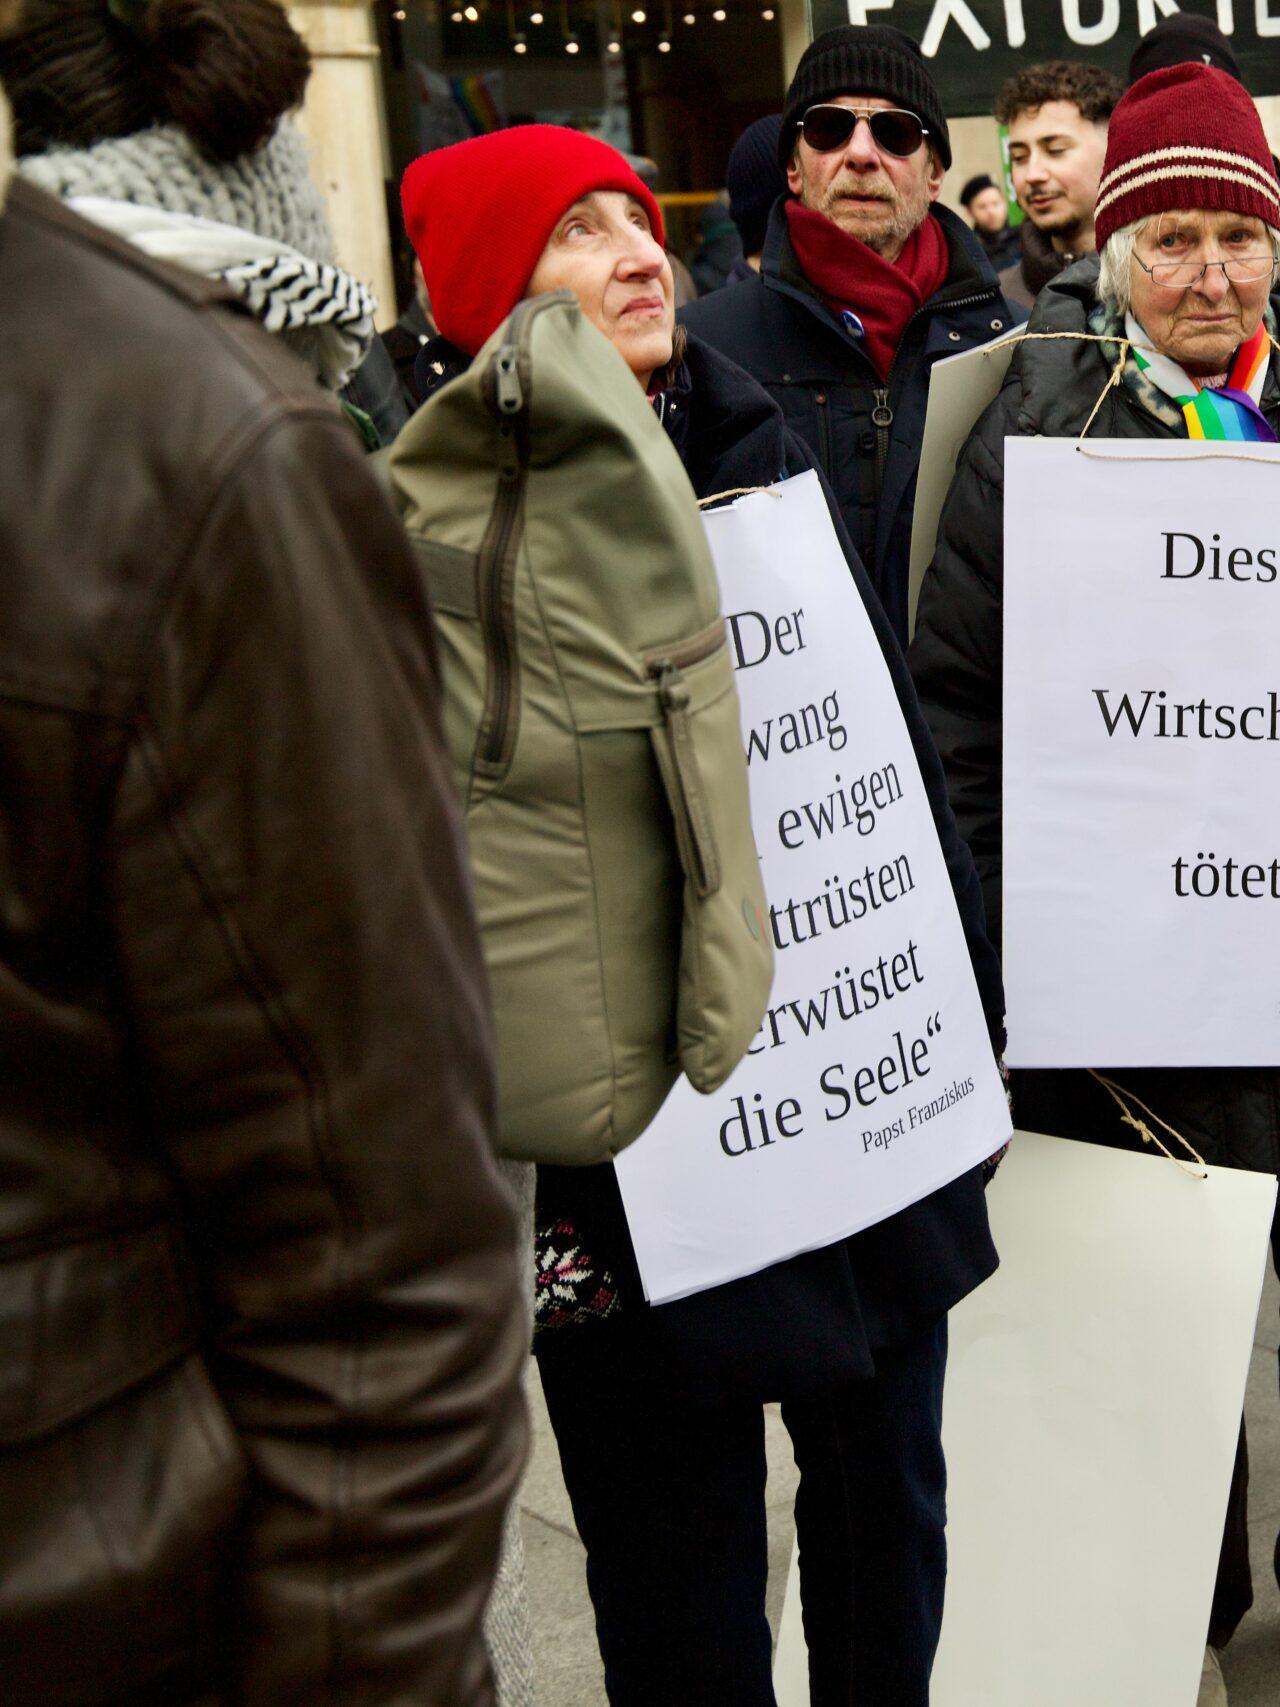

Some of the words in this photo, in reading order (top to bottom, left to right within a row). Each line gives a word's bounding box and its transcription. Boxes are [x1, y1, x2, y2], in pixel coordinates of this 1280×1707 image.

[727, 607, 808, 671] Der
[747, 689, 848, 766] wang
[777, 761, 904, 850] ewigen
[769, 853, 916, 950] ttrüsten
[747, 939, 924, 1055] rwüstet
[719, 1092, 804, 1158] die
[861, 1117, 906, 1154] Papst
[907, 1074, 976, 1131] Franziskus
